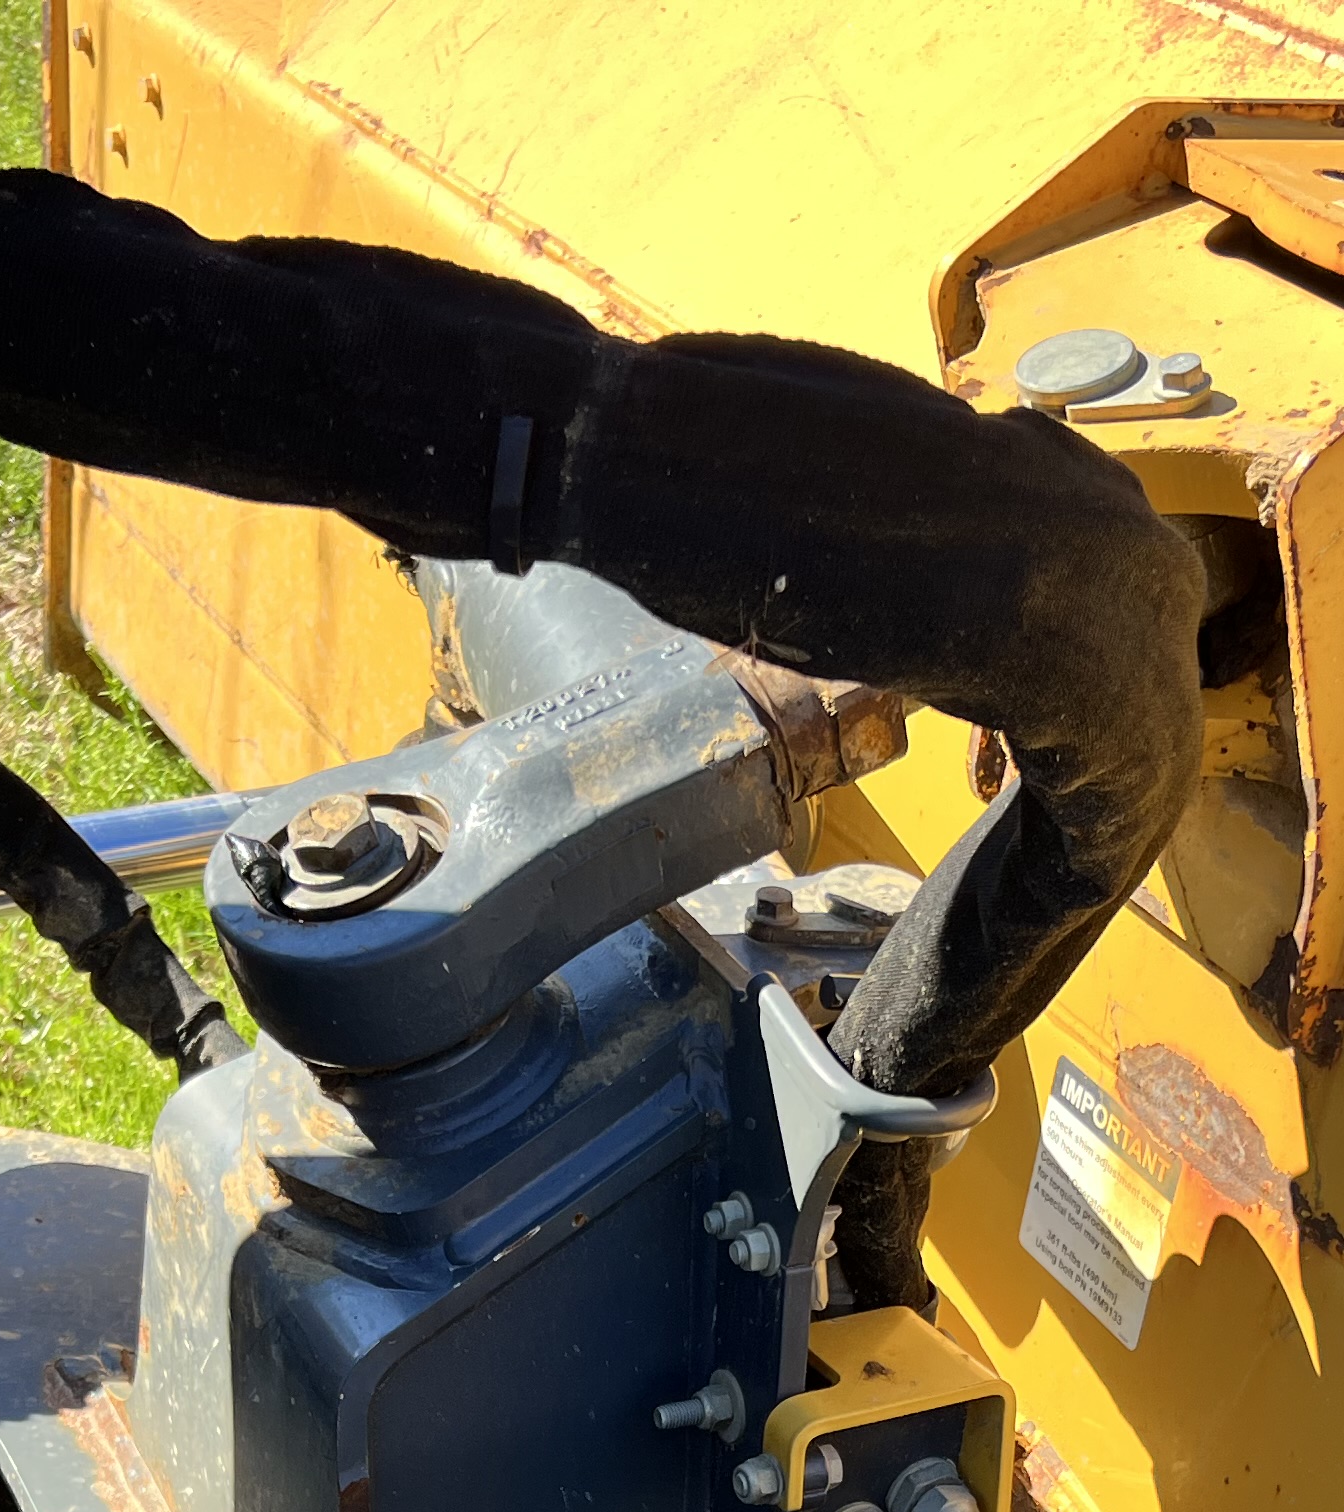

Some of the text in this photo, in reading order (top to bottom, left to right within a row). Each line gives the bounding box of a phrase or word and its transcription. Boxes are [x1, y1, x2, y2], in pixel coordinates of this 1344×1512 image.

[1045, 1126, 1085, 1167] 500 hours.
[1060, 1072, 1171, 1186] IMPORTANT
[1036, 1165, 1048, 1181] for
[1048, 1176, 1082, 1215] torquing
[1048, 1110, 1164, 1222] Check shim adjustment every
[1033, 1181, 1040, 1191] A
[1040, 1187, 1067, 1217] special
[1067, 1212, 1083, 1232] tool
[1082, 1229, 1100, 1250] may
[1100, 1244, 1111, 1259] be
[1070, 1178, 1113, 1223] Operator's
[1113, 1218, 1143, 1251] Manual
[1034, 1236, 1057, 1264] Using
[1058, 1258, 1074, 1279] bolt
[1074, 1274, 1087, 1291] PN
